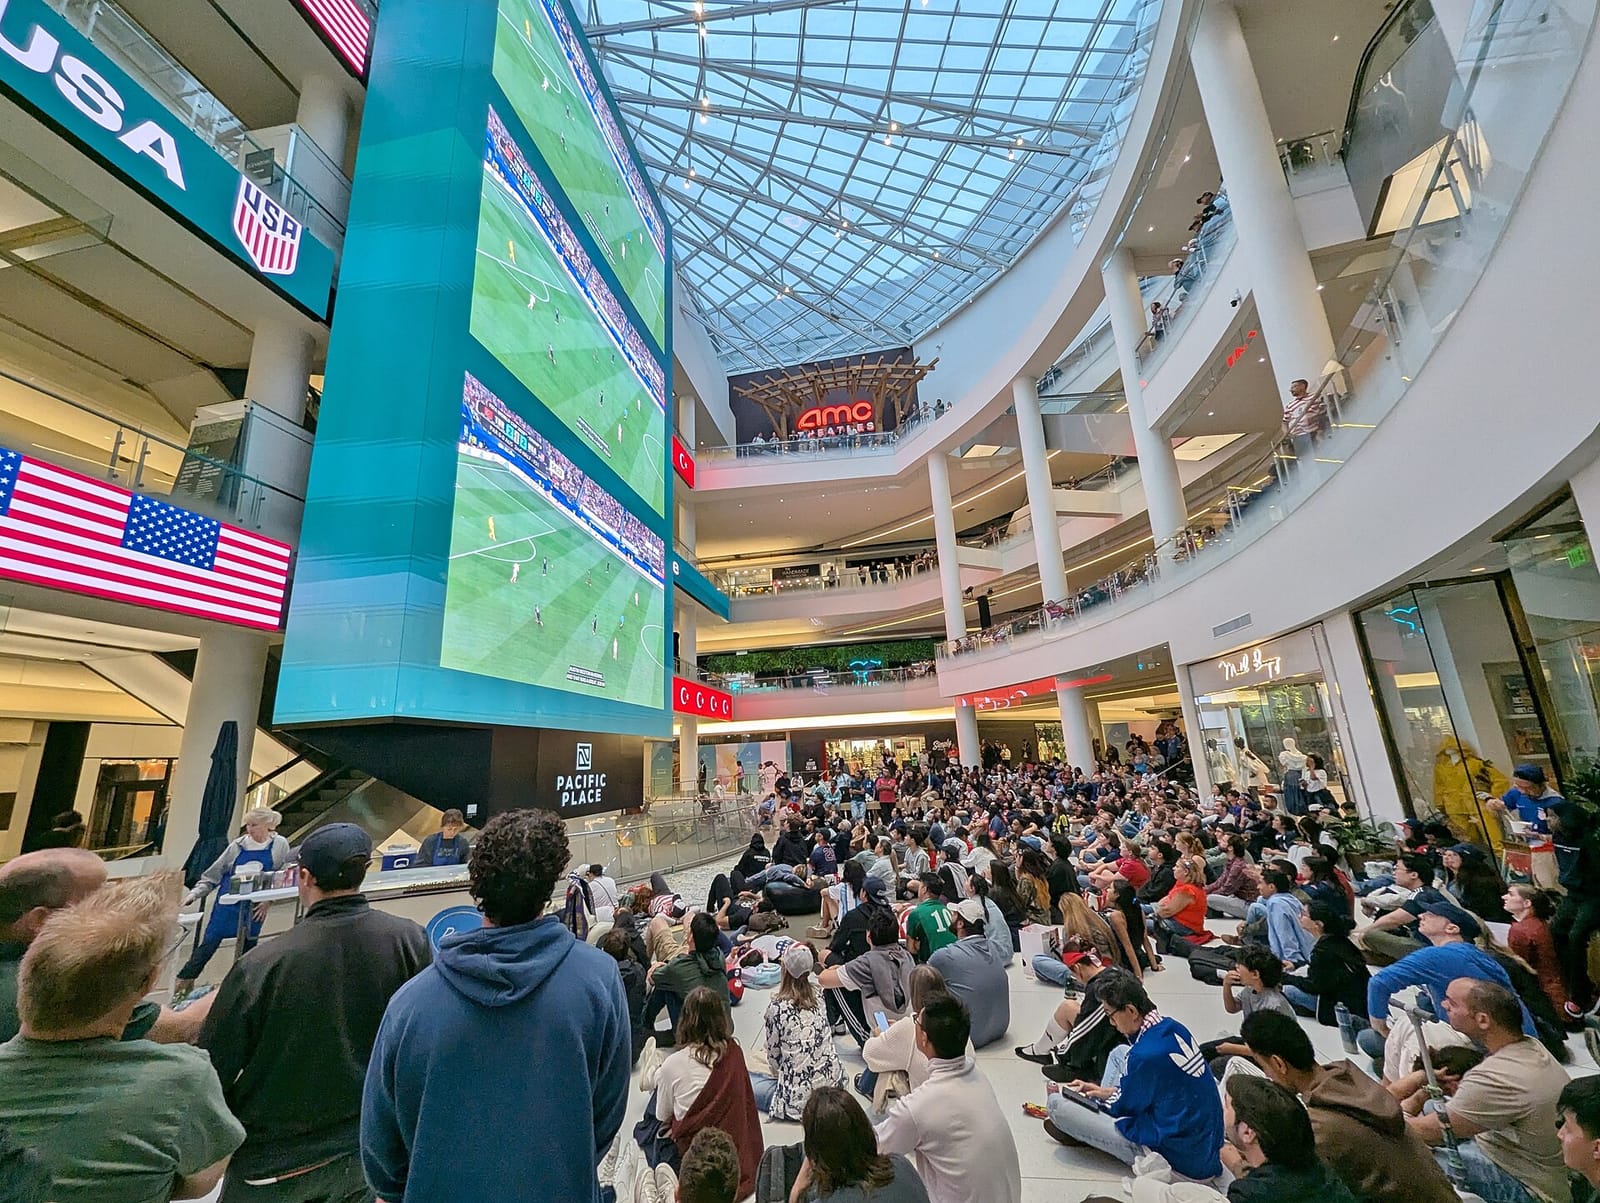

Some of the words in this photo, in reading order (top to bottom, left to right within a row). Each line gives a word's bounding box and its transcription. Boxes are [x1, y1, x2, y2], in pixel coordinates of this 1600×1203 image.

[0, 0, 186, 192] USA
[244, 181, 299, 241] USA
[556, 773, 607, 791] PACIFIC
[561, 788, 602, 807] PLACE
[930, 908, 952, 933] 10
